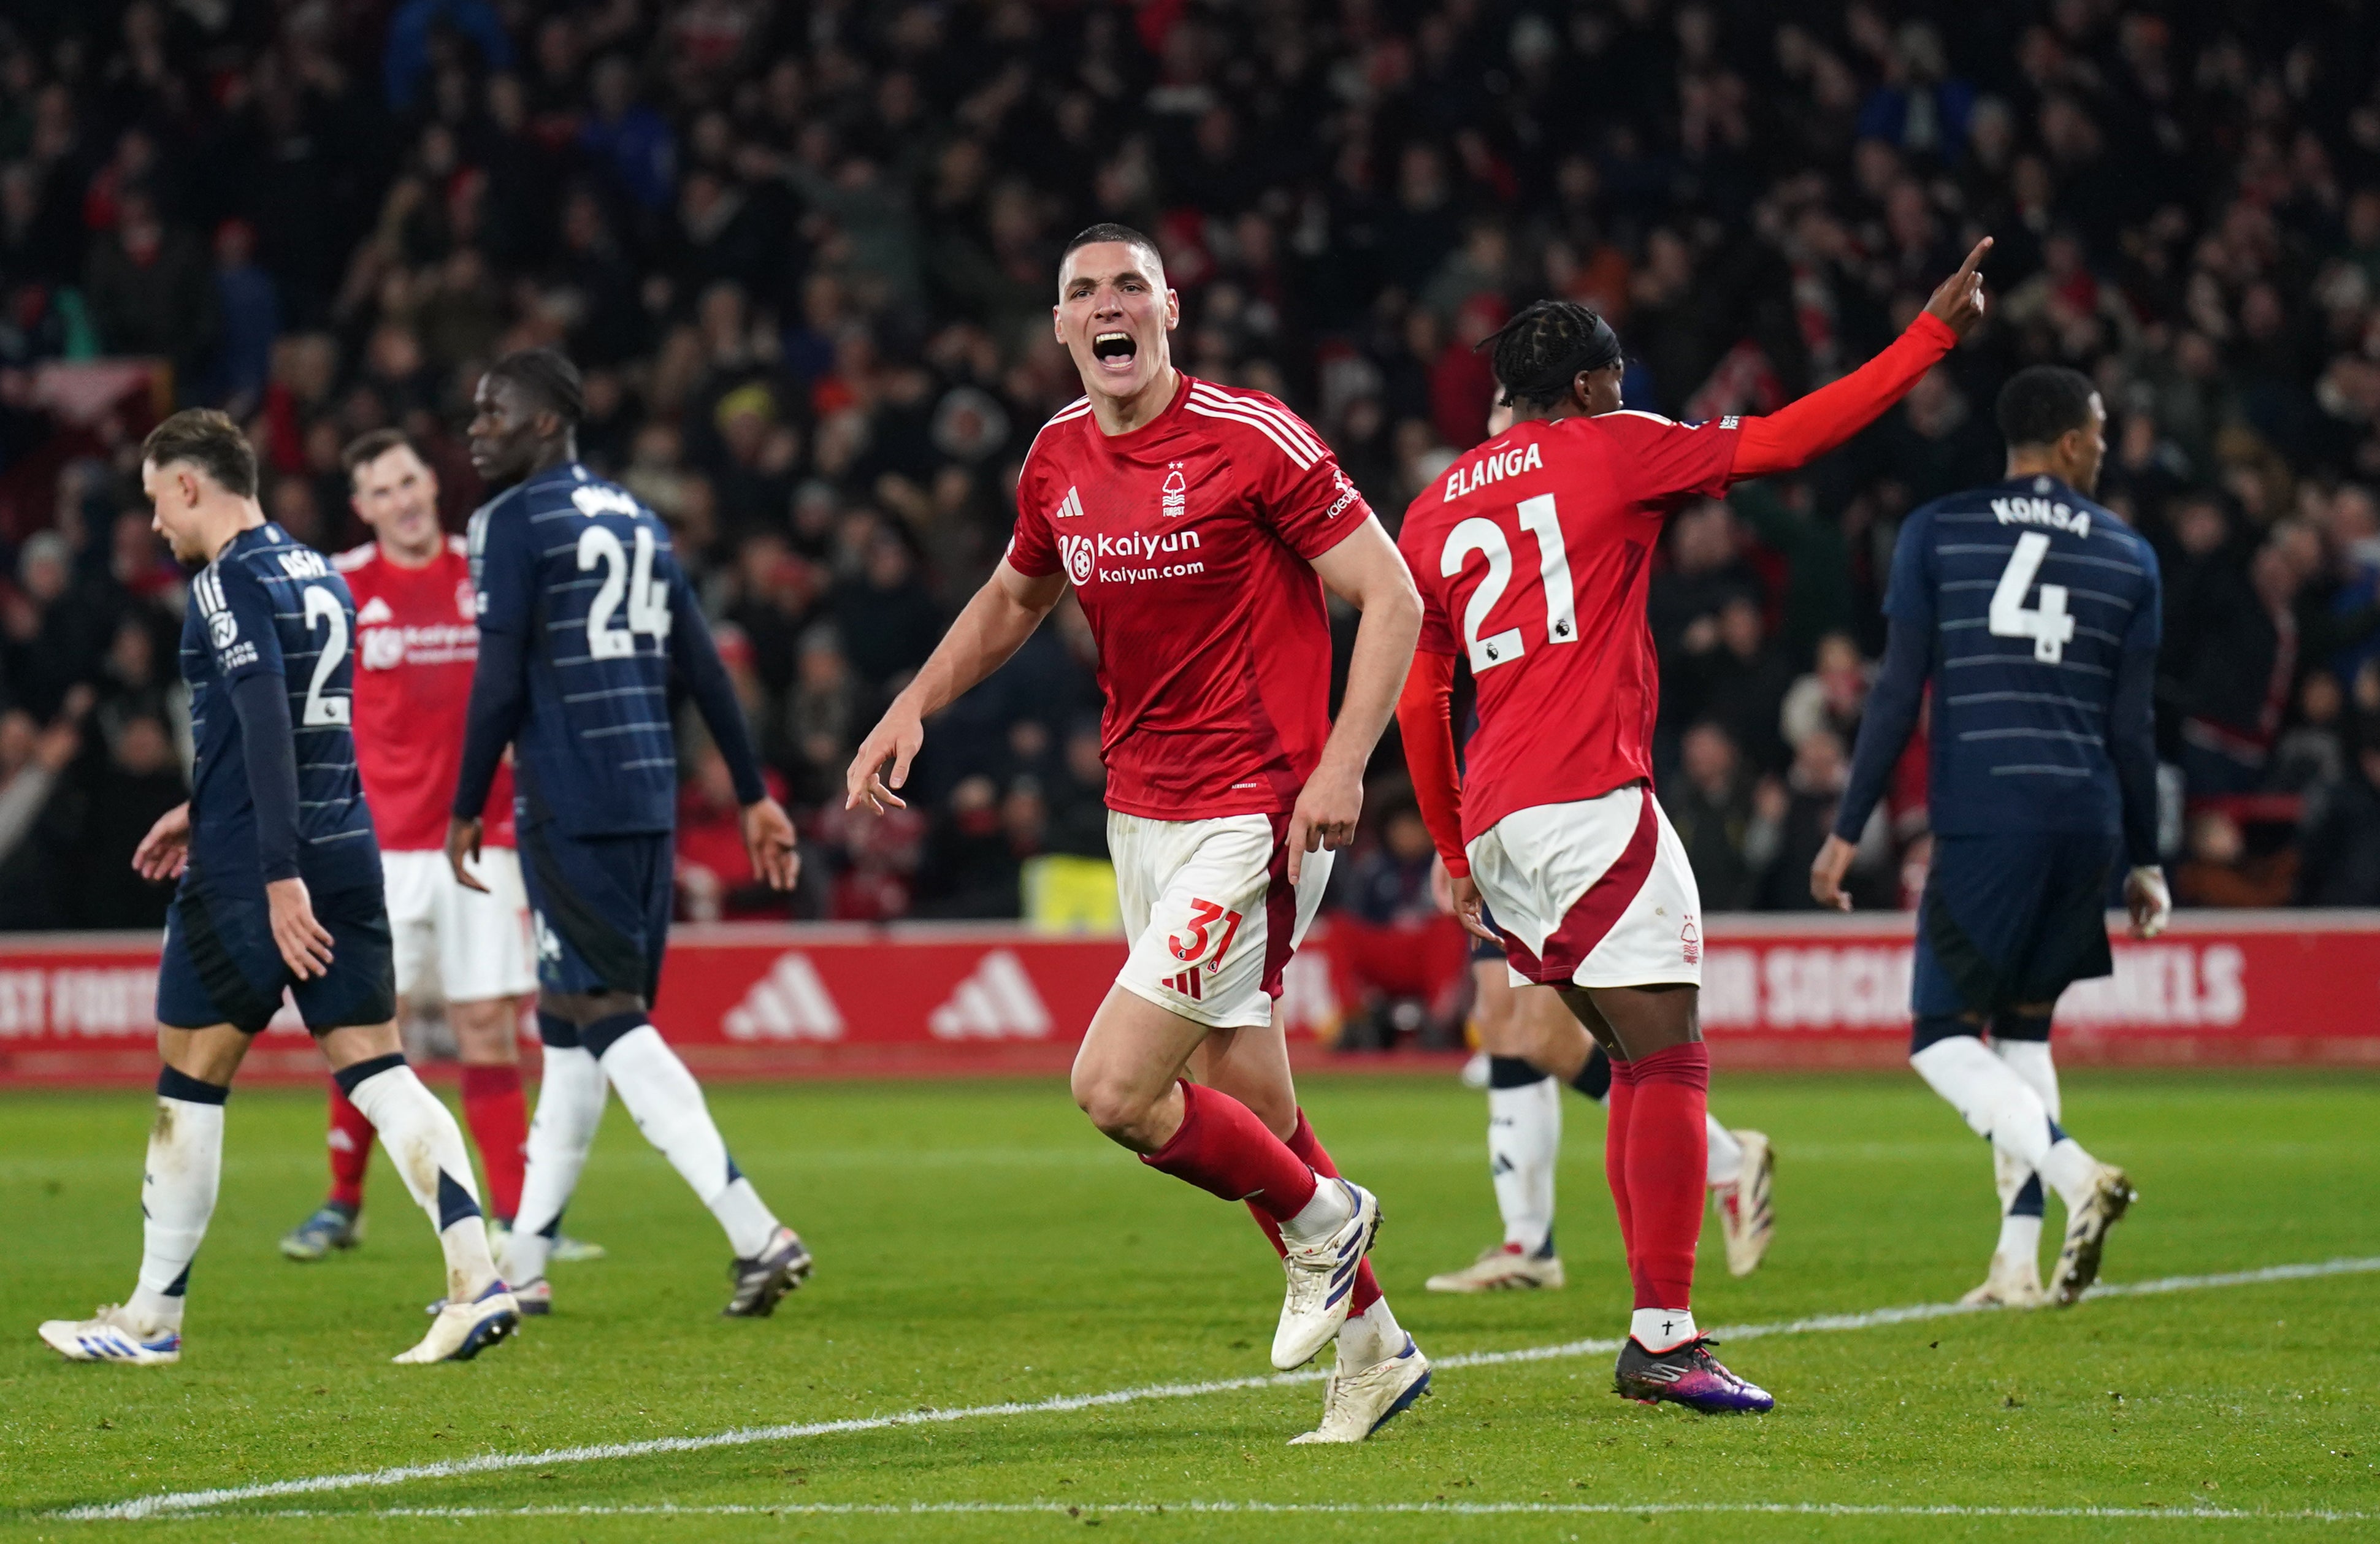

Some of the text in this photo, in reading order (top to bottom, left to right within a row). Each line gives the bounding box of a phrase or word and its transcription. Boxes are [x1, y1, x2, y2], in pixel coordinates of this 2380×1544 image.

[1443, 442, 1544, 503] ELANGA
[1098, 531, 1200, 560] kaiyun
[1991, 495, 2091, 539] KONSA
[576, 525, 672, 660] 24
[1099, 561, 1205, 584] kaiyun.com
[1440, 492, 1578, 675] 21
[1988, 530, 2075, 665] 4
[302, 584, 351, 727] 2
[1168, 896, 1243, 974] 31
